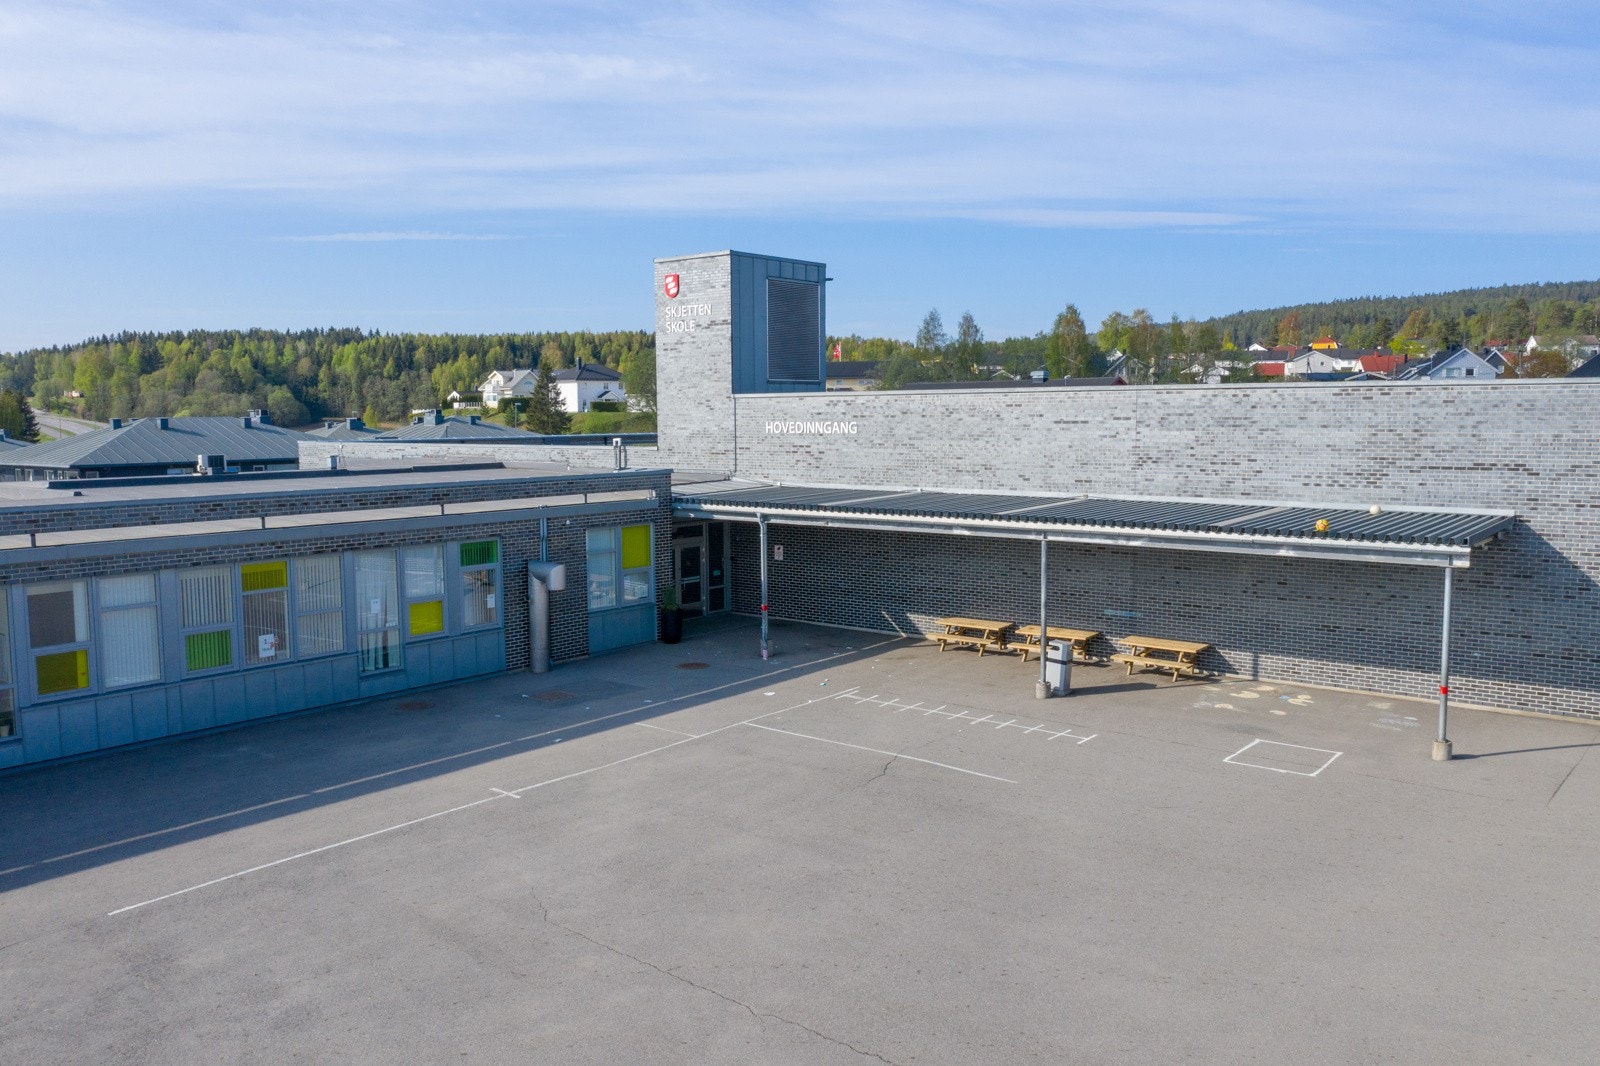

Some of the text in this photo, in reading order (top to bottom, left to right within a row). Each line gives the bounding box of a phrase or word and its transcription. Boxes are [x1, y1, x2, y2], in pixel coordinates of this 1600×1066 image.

[665, 304, 712, 318] SKJETTEN
[666, 320, 696, 333] SKOLE
[765, 421, 858, 434] HOVEDINNGANG
